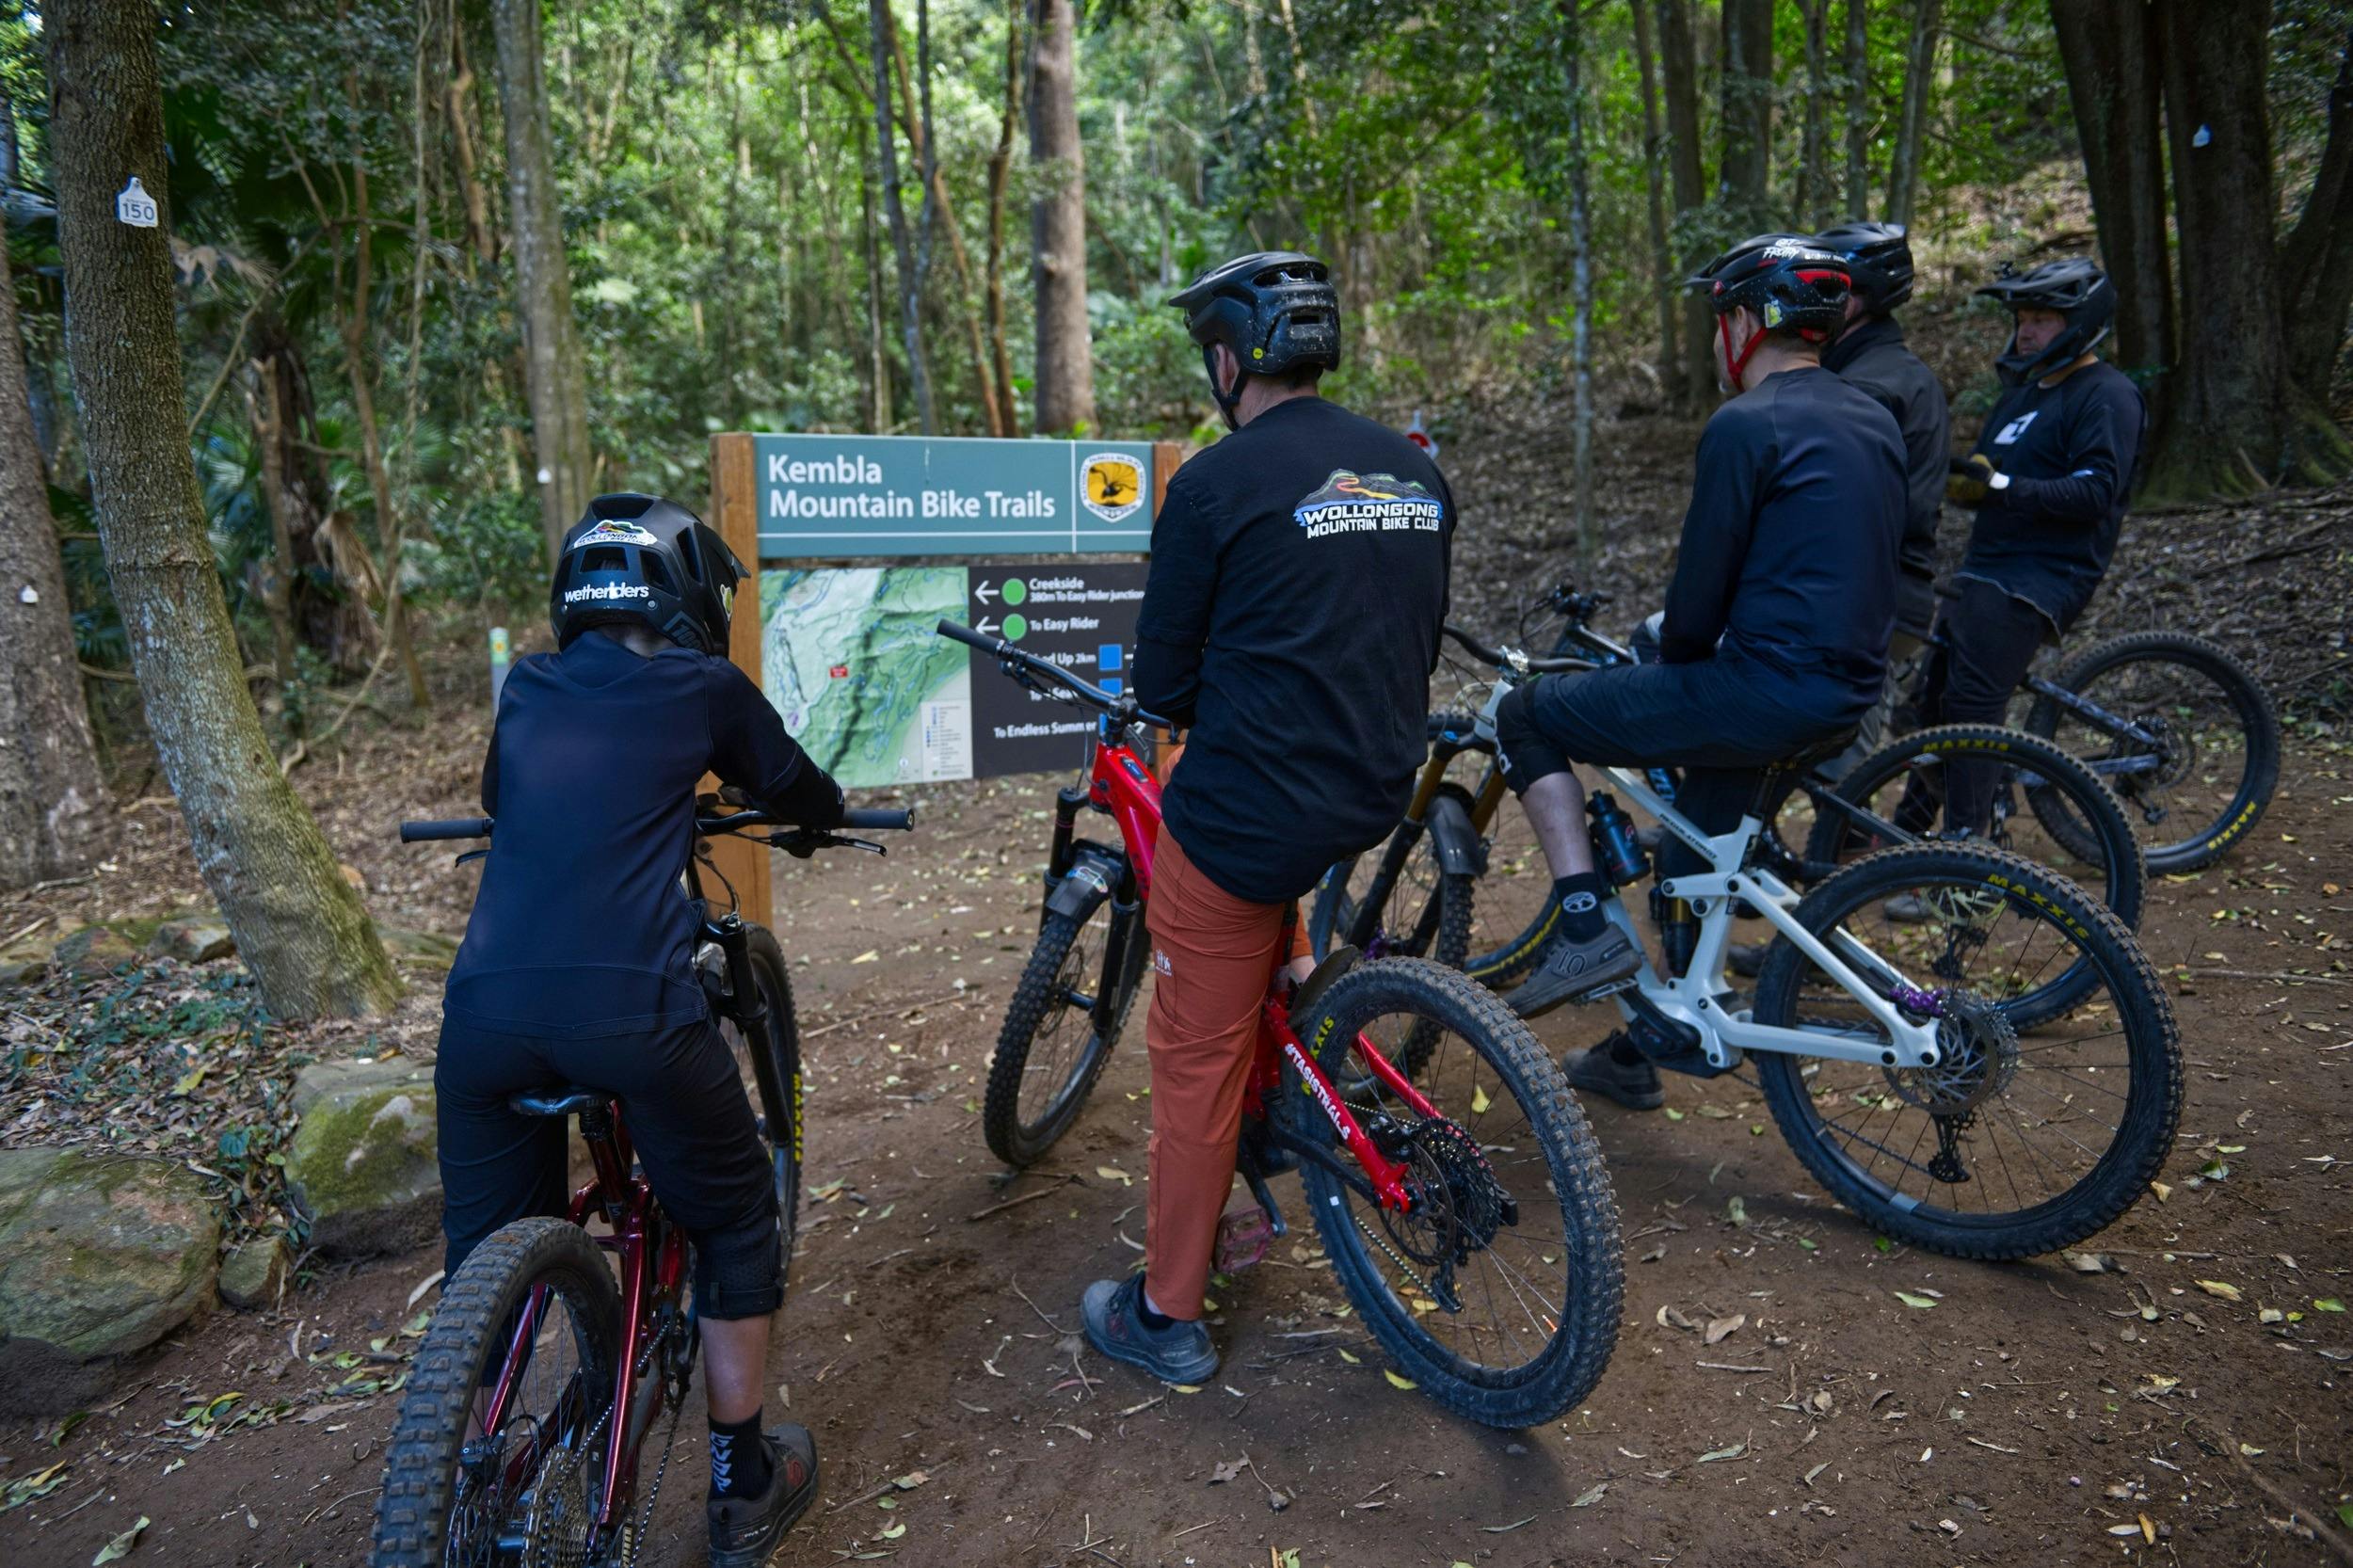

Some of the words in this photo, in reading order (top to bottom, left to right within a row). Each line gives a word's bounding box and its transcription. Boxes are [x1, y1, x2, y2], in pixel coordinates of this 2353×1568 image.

[122, 202, 154, 221] 150
[768, 455, 883, 484] Kembla
[770, 489, 914, 518] Mountain
[922, 490, 981, 519] Bike
[984, 490, 1055, 518] Trails
[1303, 504, 1439, 525] WOLLONGONG
[1306, 519, 1377, 539] MOUNTAIN
[1382, 517, 1410, 531] BIKE
[1414, 518, 1439, 532] CLUB
[1029, 577, 1084, 591] Creekside
[1055, 591, 1066, 602] To
[1066, 591, 1086, 603] Easy
[1087, 590, 1110, 601] Rider
[1109, 589, 1144, 603] junction
[1030, 620, 1042, 632] To
[1044, 618, 1068, 632] Easy
[1070, 616, 1099, 630] Rider
[1057, 652, 1075, 666] Up
[1075, 652, 1096, 664] 2km
[994, 727, 1006, 739] To
[1007, 723, 1050, 738] Endless
[1051, 721, 1097, 735] Summer
[1923, 739, 2009, 753] MAXXIS
[1987, 873, 2090, 940] MAXXIS
[1301, 1016, 1335, 1096] MXXIS
